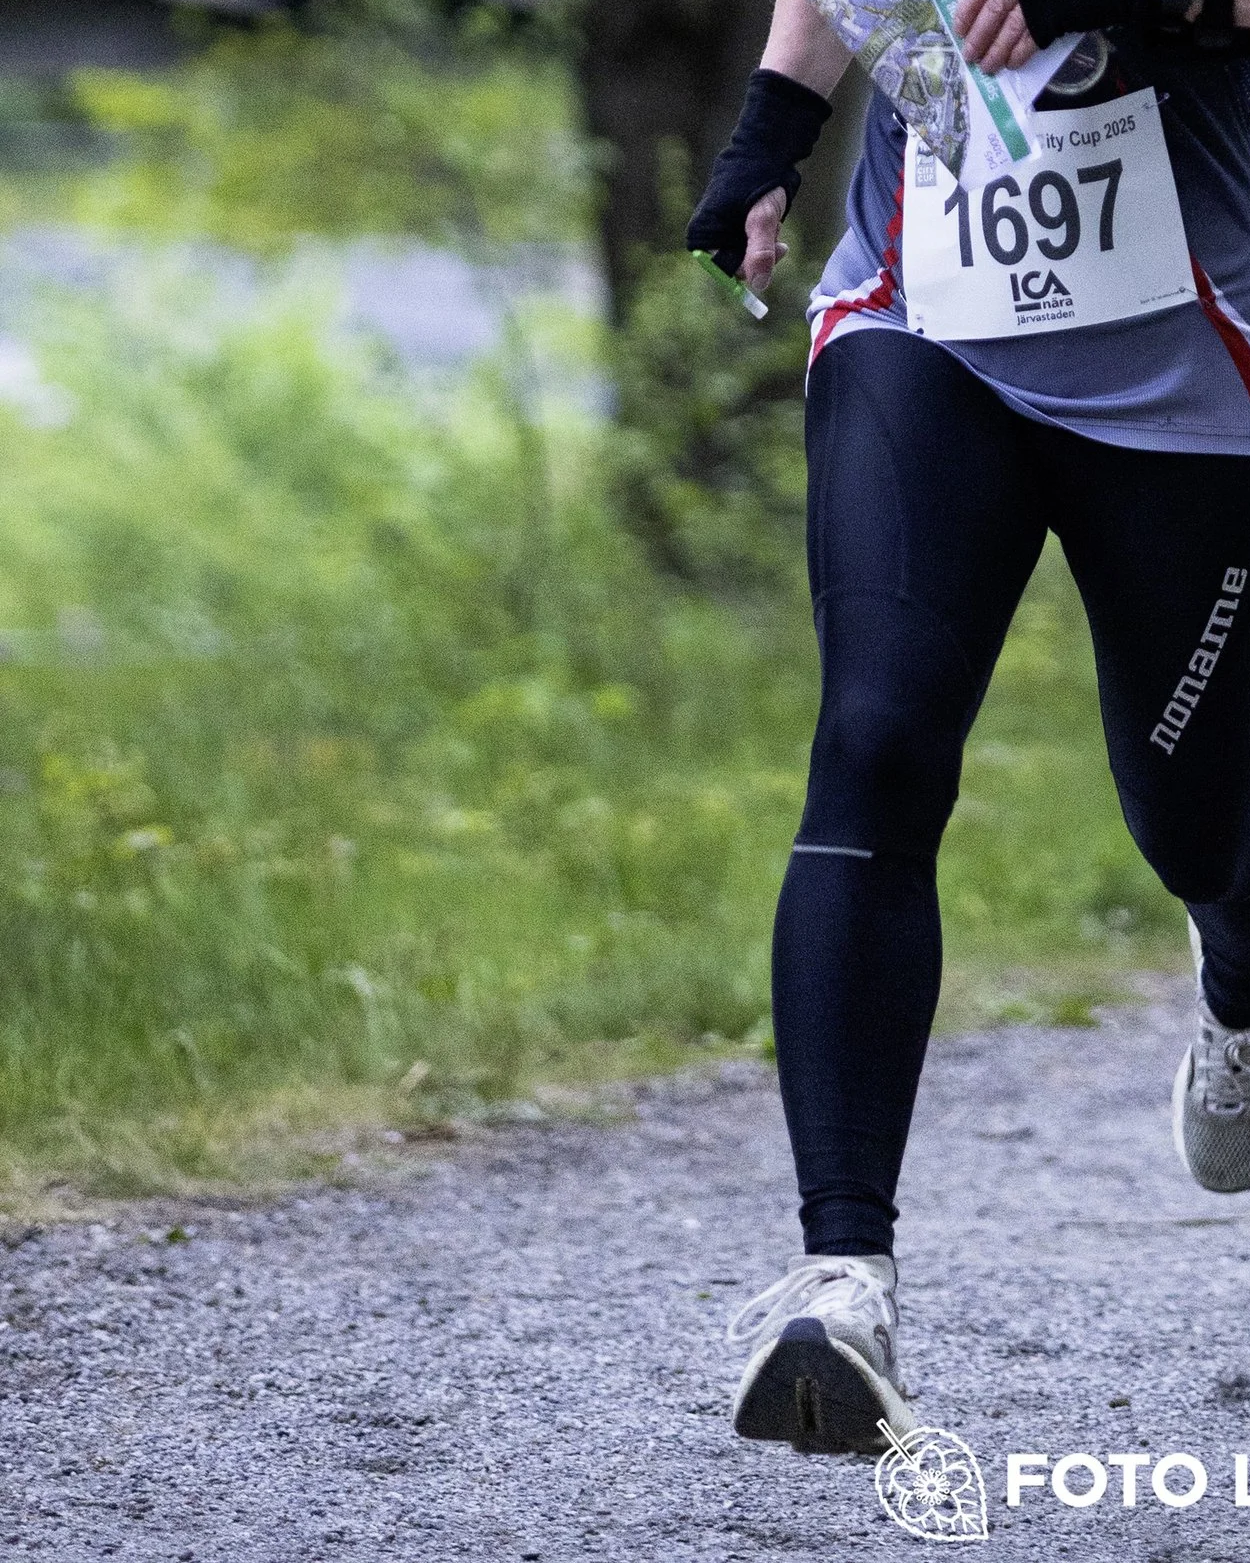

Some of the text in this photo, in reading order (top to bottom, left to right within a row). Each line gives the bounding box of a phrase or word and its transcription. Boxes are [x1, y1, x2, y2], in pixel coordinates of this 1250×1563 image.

[1042, 115, 1136, 152] ity Cup 2025
[944, 158, 1124, 268] 1697
[1009, 269, 1071, 302] ICA
[1016, 309, 1076, 326] Järvastaden
[1042, 297, 1074, 310] nära
[1149, 566, 1248, 756] noname
